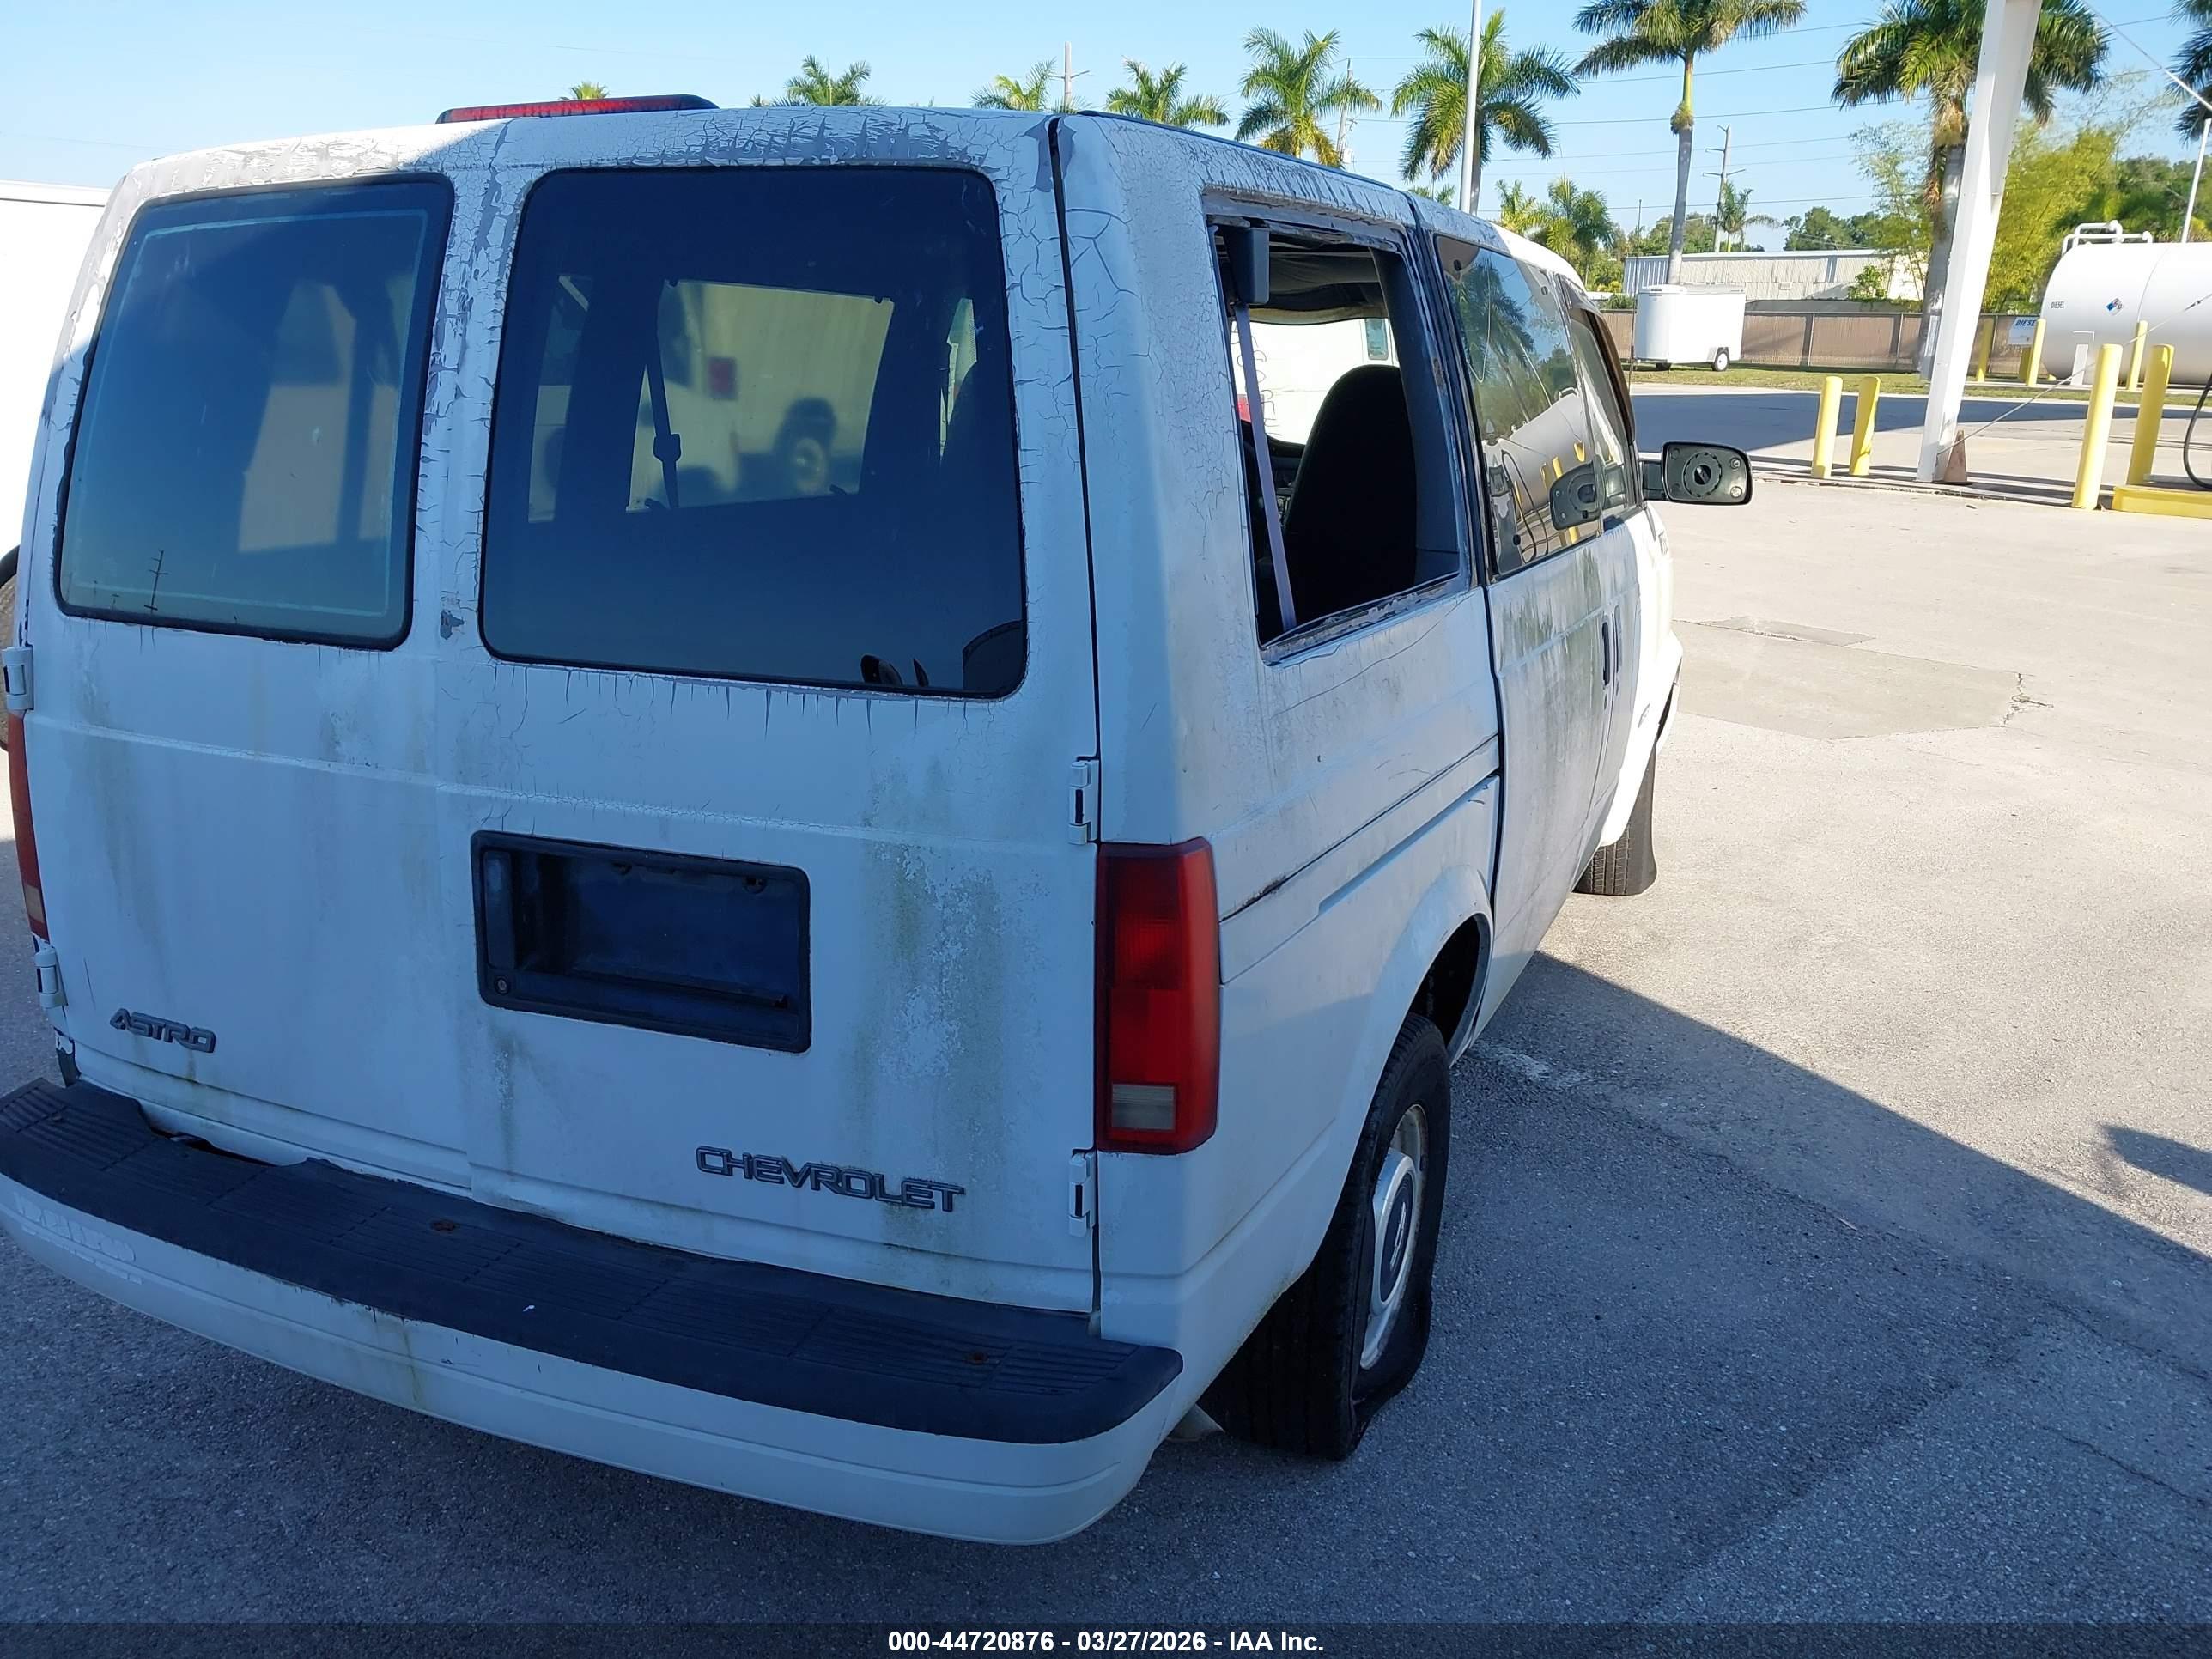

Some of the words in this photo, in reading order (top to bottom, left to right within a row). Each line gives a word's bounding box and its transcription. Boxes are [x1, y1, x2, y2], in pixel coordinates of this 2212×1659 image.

[2051, 301, 2065, 309] DIESEL
[109, 1007, 216, 1054] ASTRO
[696, 1145, 966, 1212] CHEVROLET
